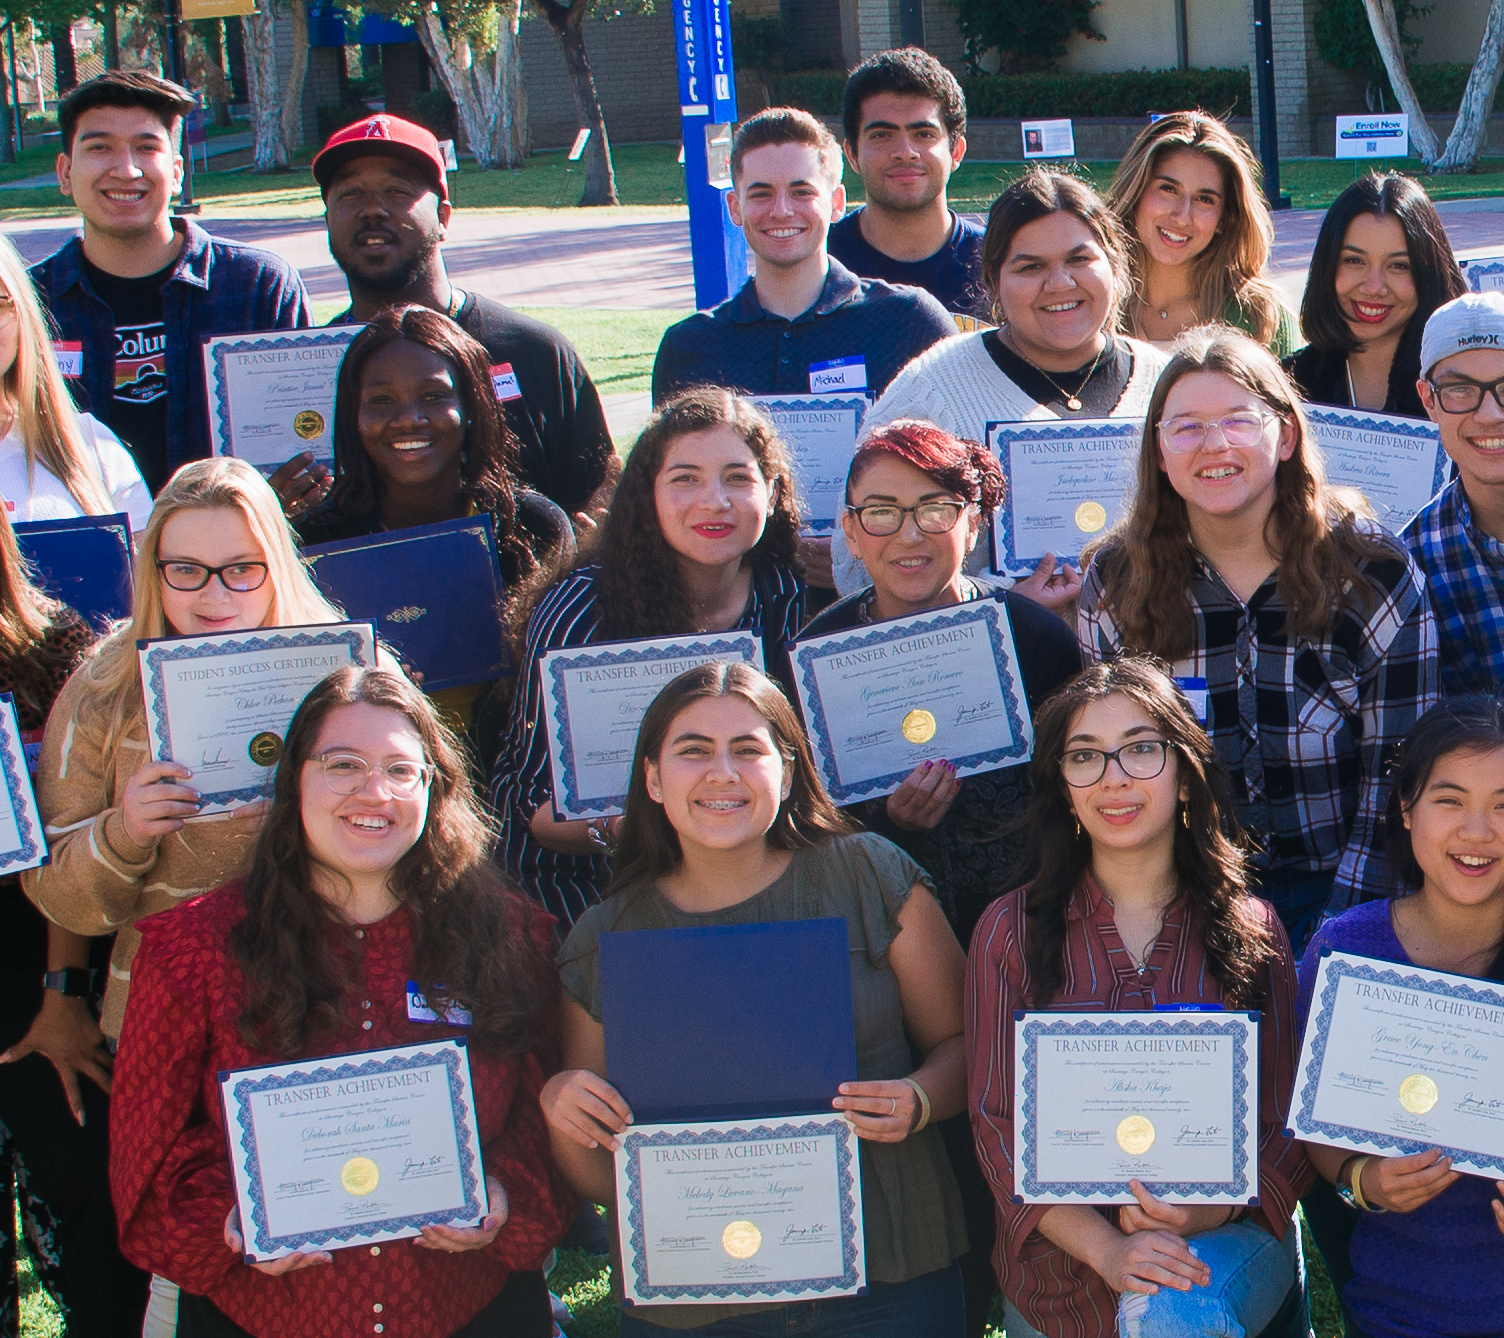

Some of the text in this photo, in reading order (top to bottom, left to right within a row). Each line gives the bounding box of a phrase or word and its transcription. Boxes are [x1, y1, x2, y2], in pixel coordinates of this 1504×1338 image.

[1356, 121, 1401, 130] Enroll Now
[1458, 335, 1488, 347] Hurley
[237, 348, 345, 366] TRANSFER ACHIEVE
[771, 413, 844, 424] ACHIEVEMENT
[1021, 438, 1143, 455] TRANSFER ACHIEVEME
[1310, 425, 1427, 452] RANSFER ACHIEVEMENT
[827, 647, 889, 671] TRANSFER
[891, 626, 976, 656] ACHIEVEMENT
[177, 655, 341, 682] STUDENT SUCCESS CERTIFICATE
[576, 666, 638, 683] TRANSFER
[1355, 982, 1419, 1008] TRANSFER
[1053, 1039, 1220, 1052] TRANSFER ACHIEVEMENT
[1371, 1026, 1402, 1043] Grace
[1463, 1043, 1489, 1062] Chen
[264, 1085, 332, 1107] TRANSFER
[336, 1070, 432, 1096] ACHIEVEMENT
[344, 1120, 375, 1136] Santa
[377, 1114, 411, 1131] Maria
[652, 1140, 820, 1163] TRANSFER ACHIEVEMENT
[677, 1185, 715, 1202] Melody
